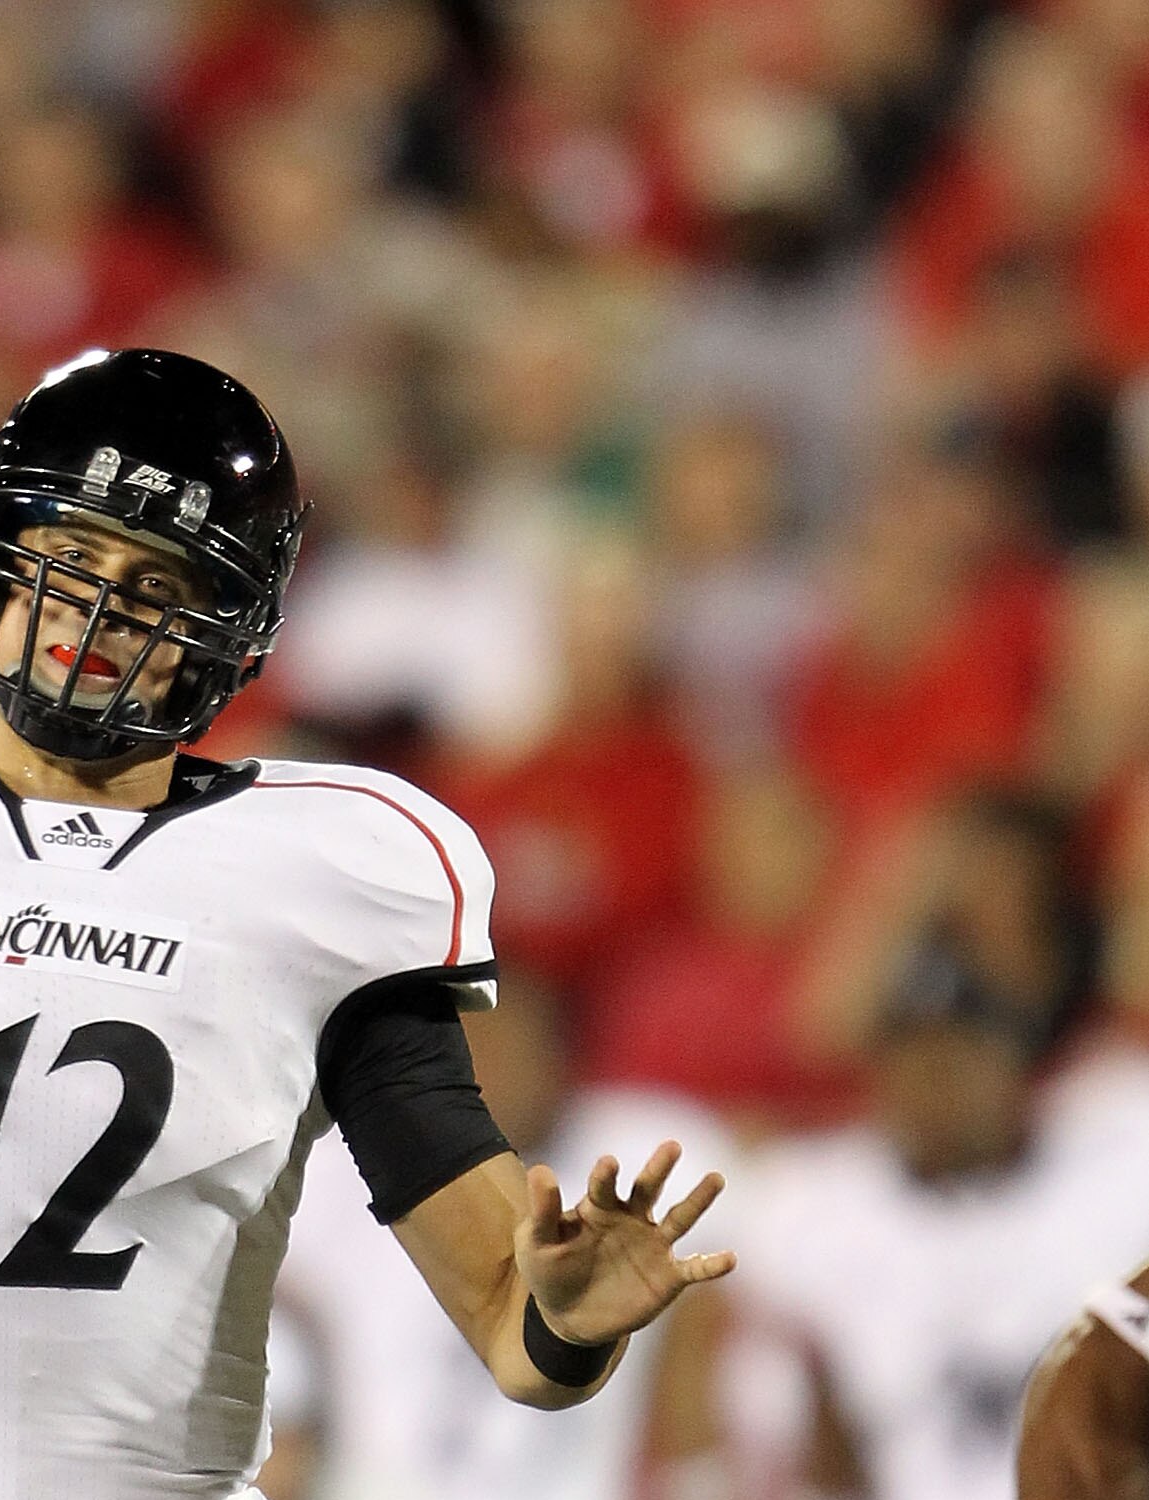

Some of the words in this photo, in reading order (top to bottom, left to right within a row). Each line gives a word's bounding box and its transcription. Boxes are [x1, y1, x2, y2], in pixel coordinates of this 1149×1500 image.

[128, 473, 177, 494] EAST
[138, 465, 172, 482] BIG
[41, 830, 114, 850] adidas
